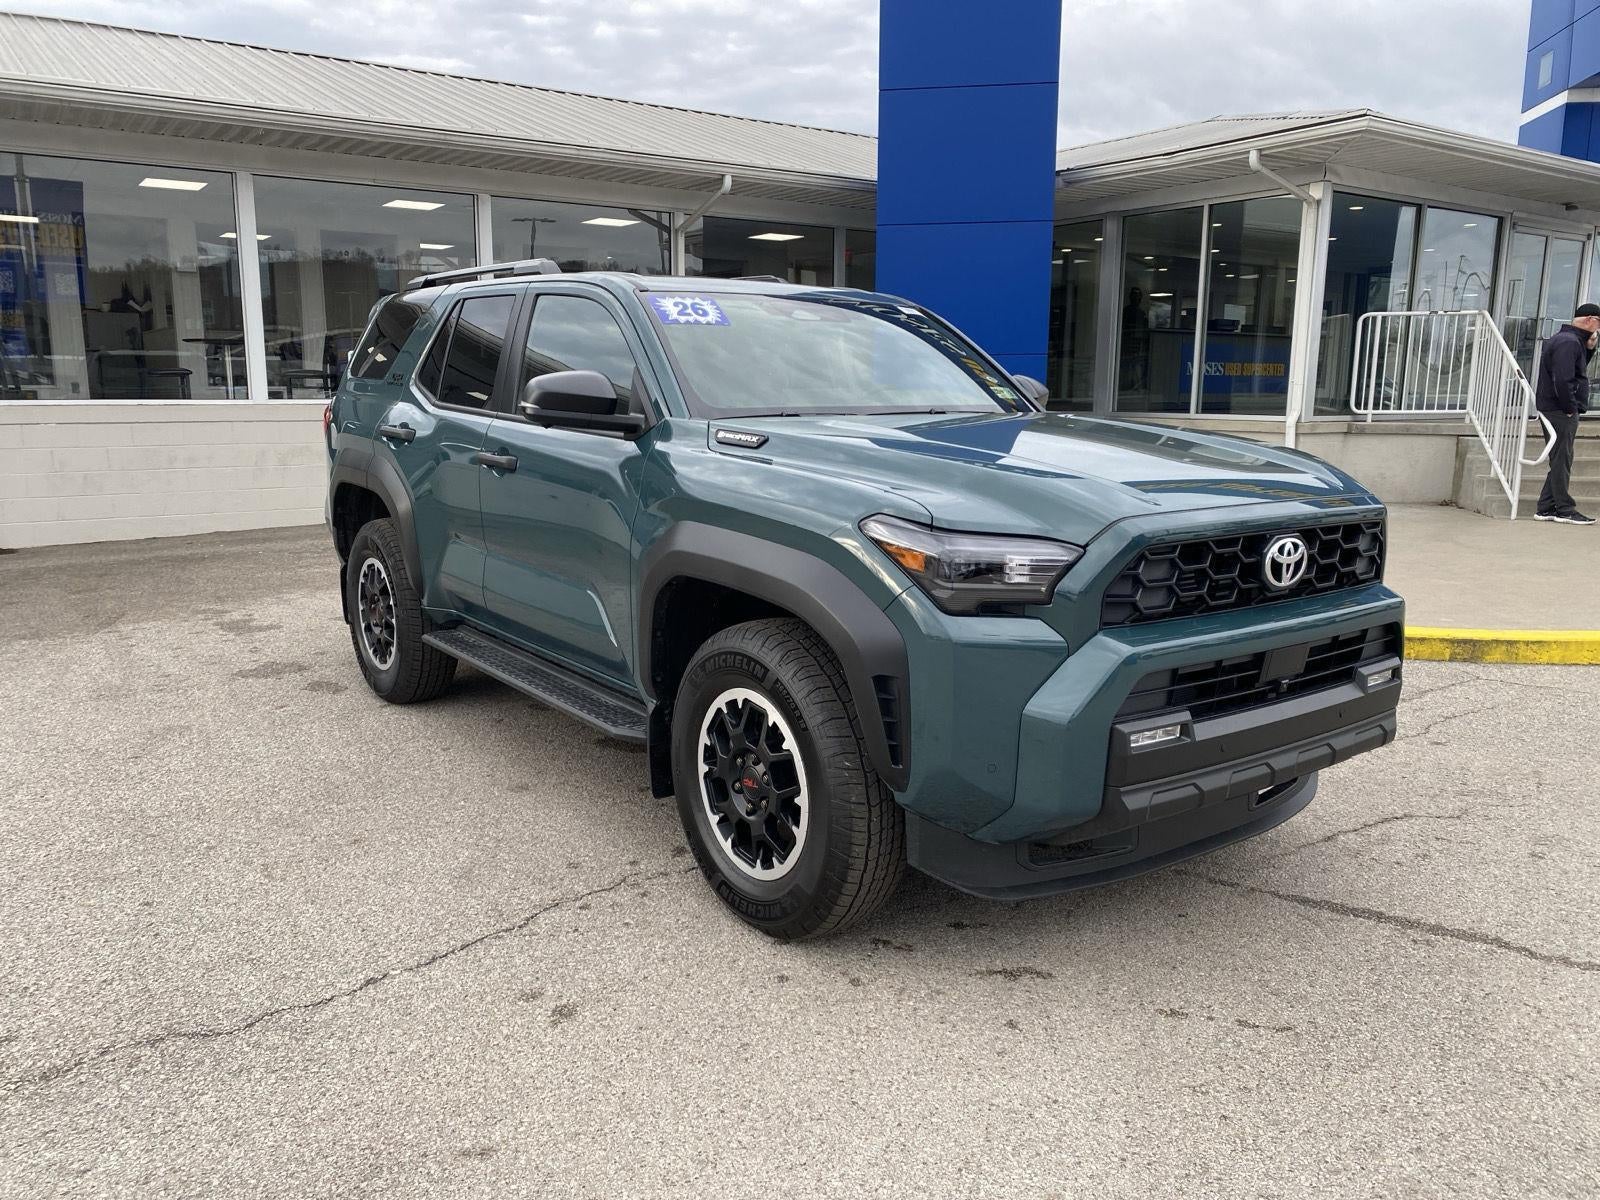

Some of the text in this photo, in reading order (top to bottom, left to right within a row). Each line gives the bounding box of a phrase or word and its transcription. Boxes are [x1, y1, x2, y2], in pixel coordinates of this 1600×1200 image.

[673, 301, 710, 318] 26
[1186, 361, 1225, 376] MSES
[704, 654, 769, 680] MICHELIN
[719, 884, 780, 918] MICHELIN
